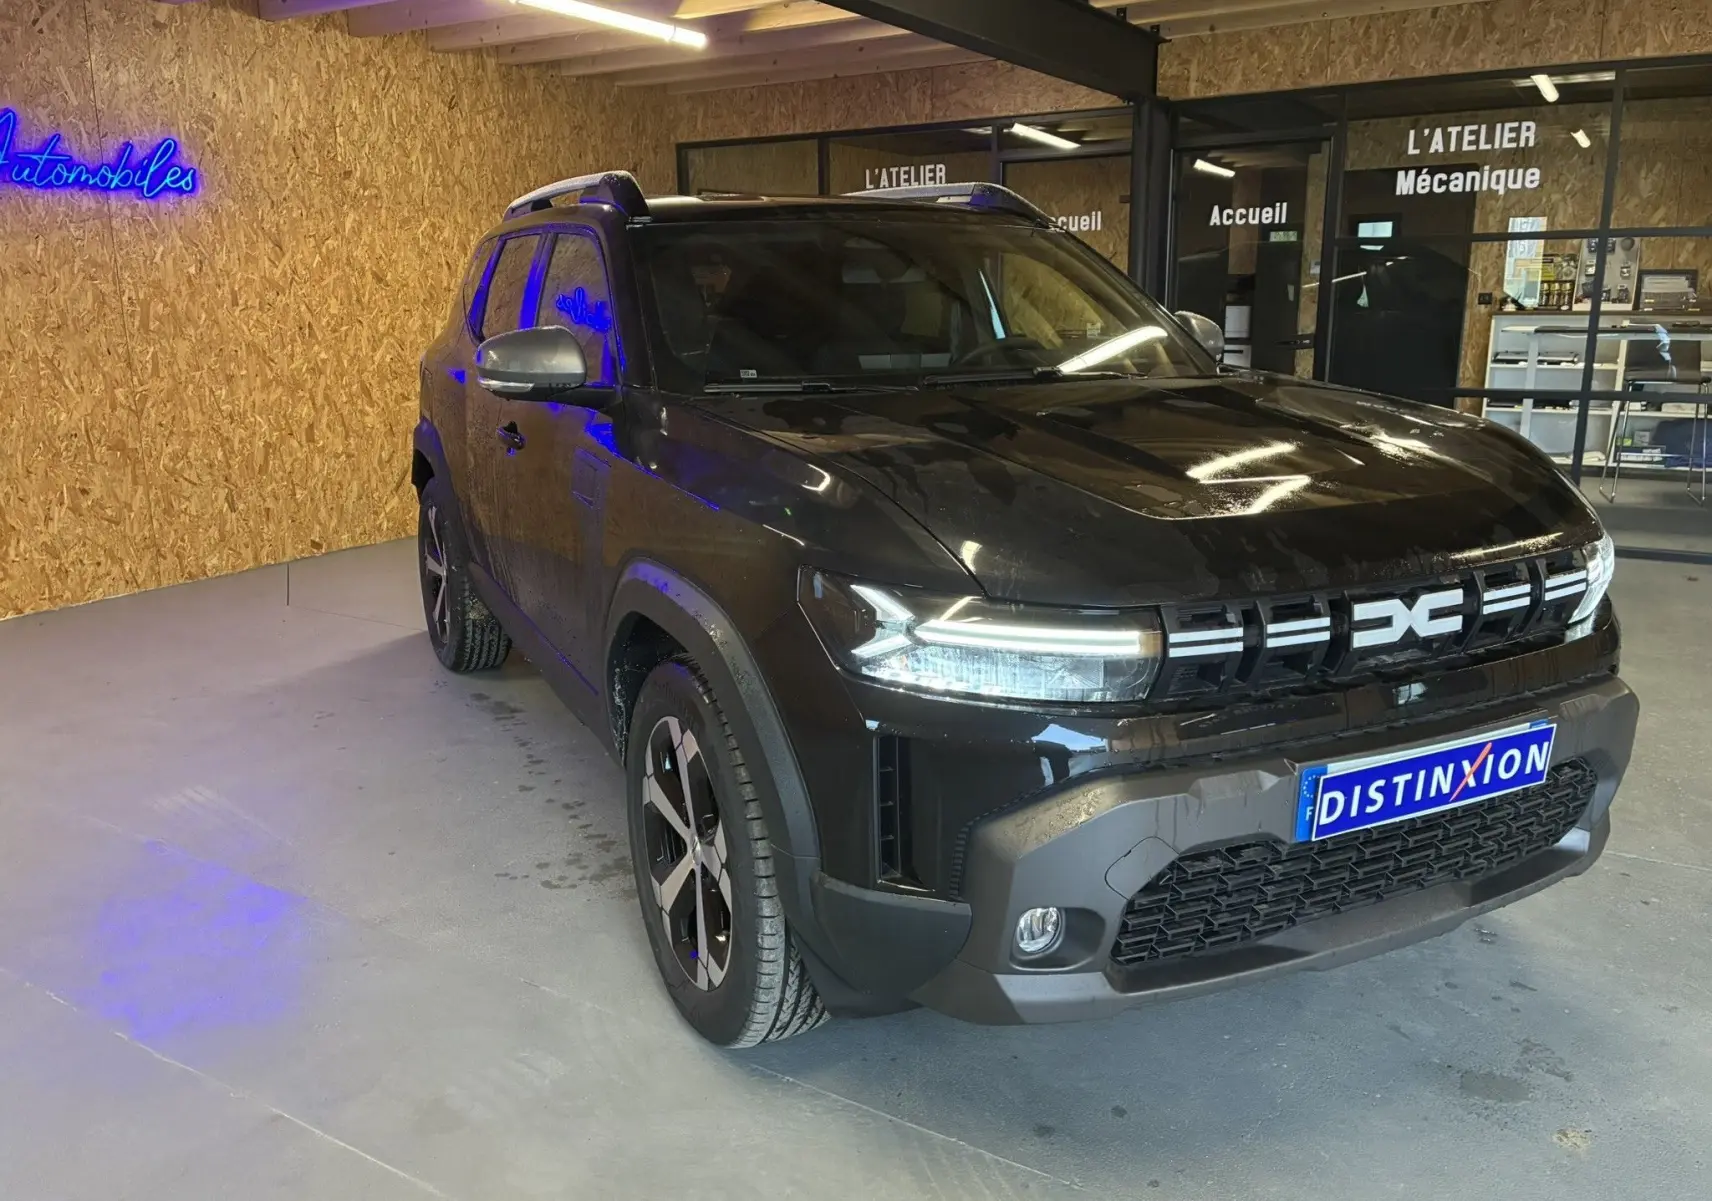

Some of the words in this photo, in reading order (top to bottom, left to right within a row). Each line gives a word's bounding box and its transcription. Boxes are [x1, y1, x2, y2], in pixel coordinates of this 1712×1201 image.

[1407, 120, 1537, 156] L'ATELIER
[865, 163, 947, 190] L'ATELIER
[1395, 164, 1542, 196] Mécanique
[1209, 201, 1289, 226] Accueil
[1318, 741, 1550, 826] DISTINXION
[1305, 806, 1314, 821] F
